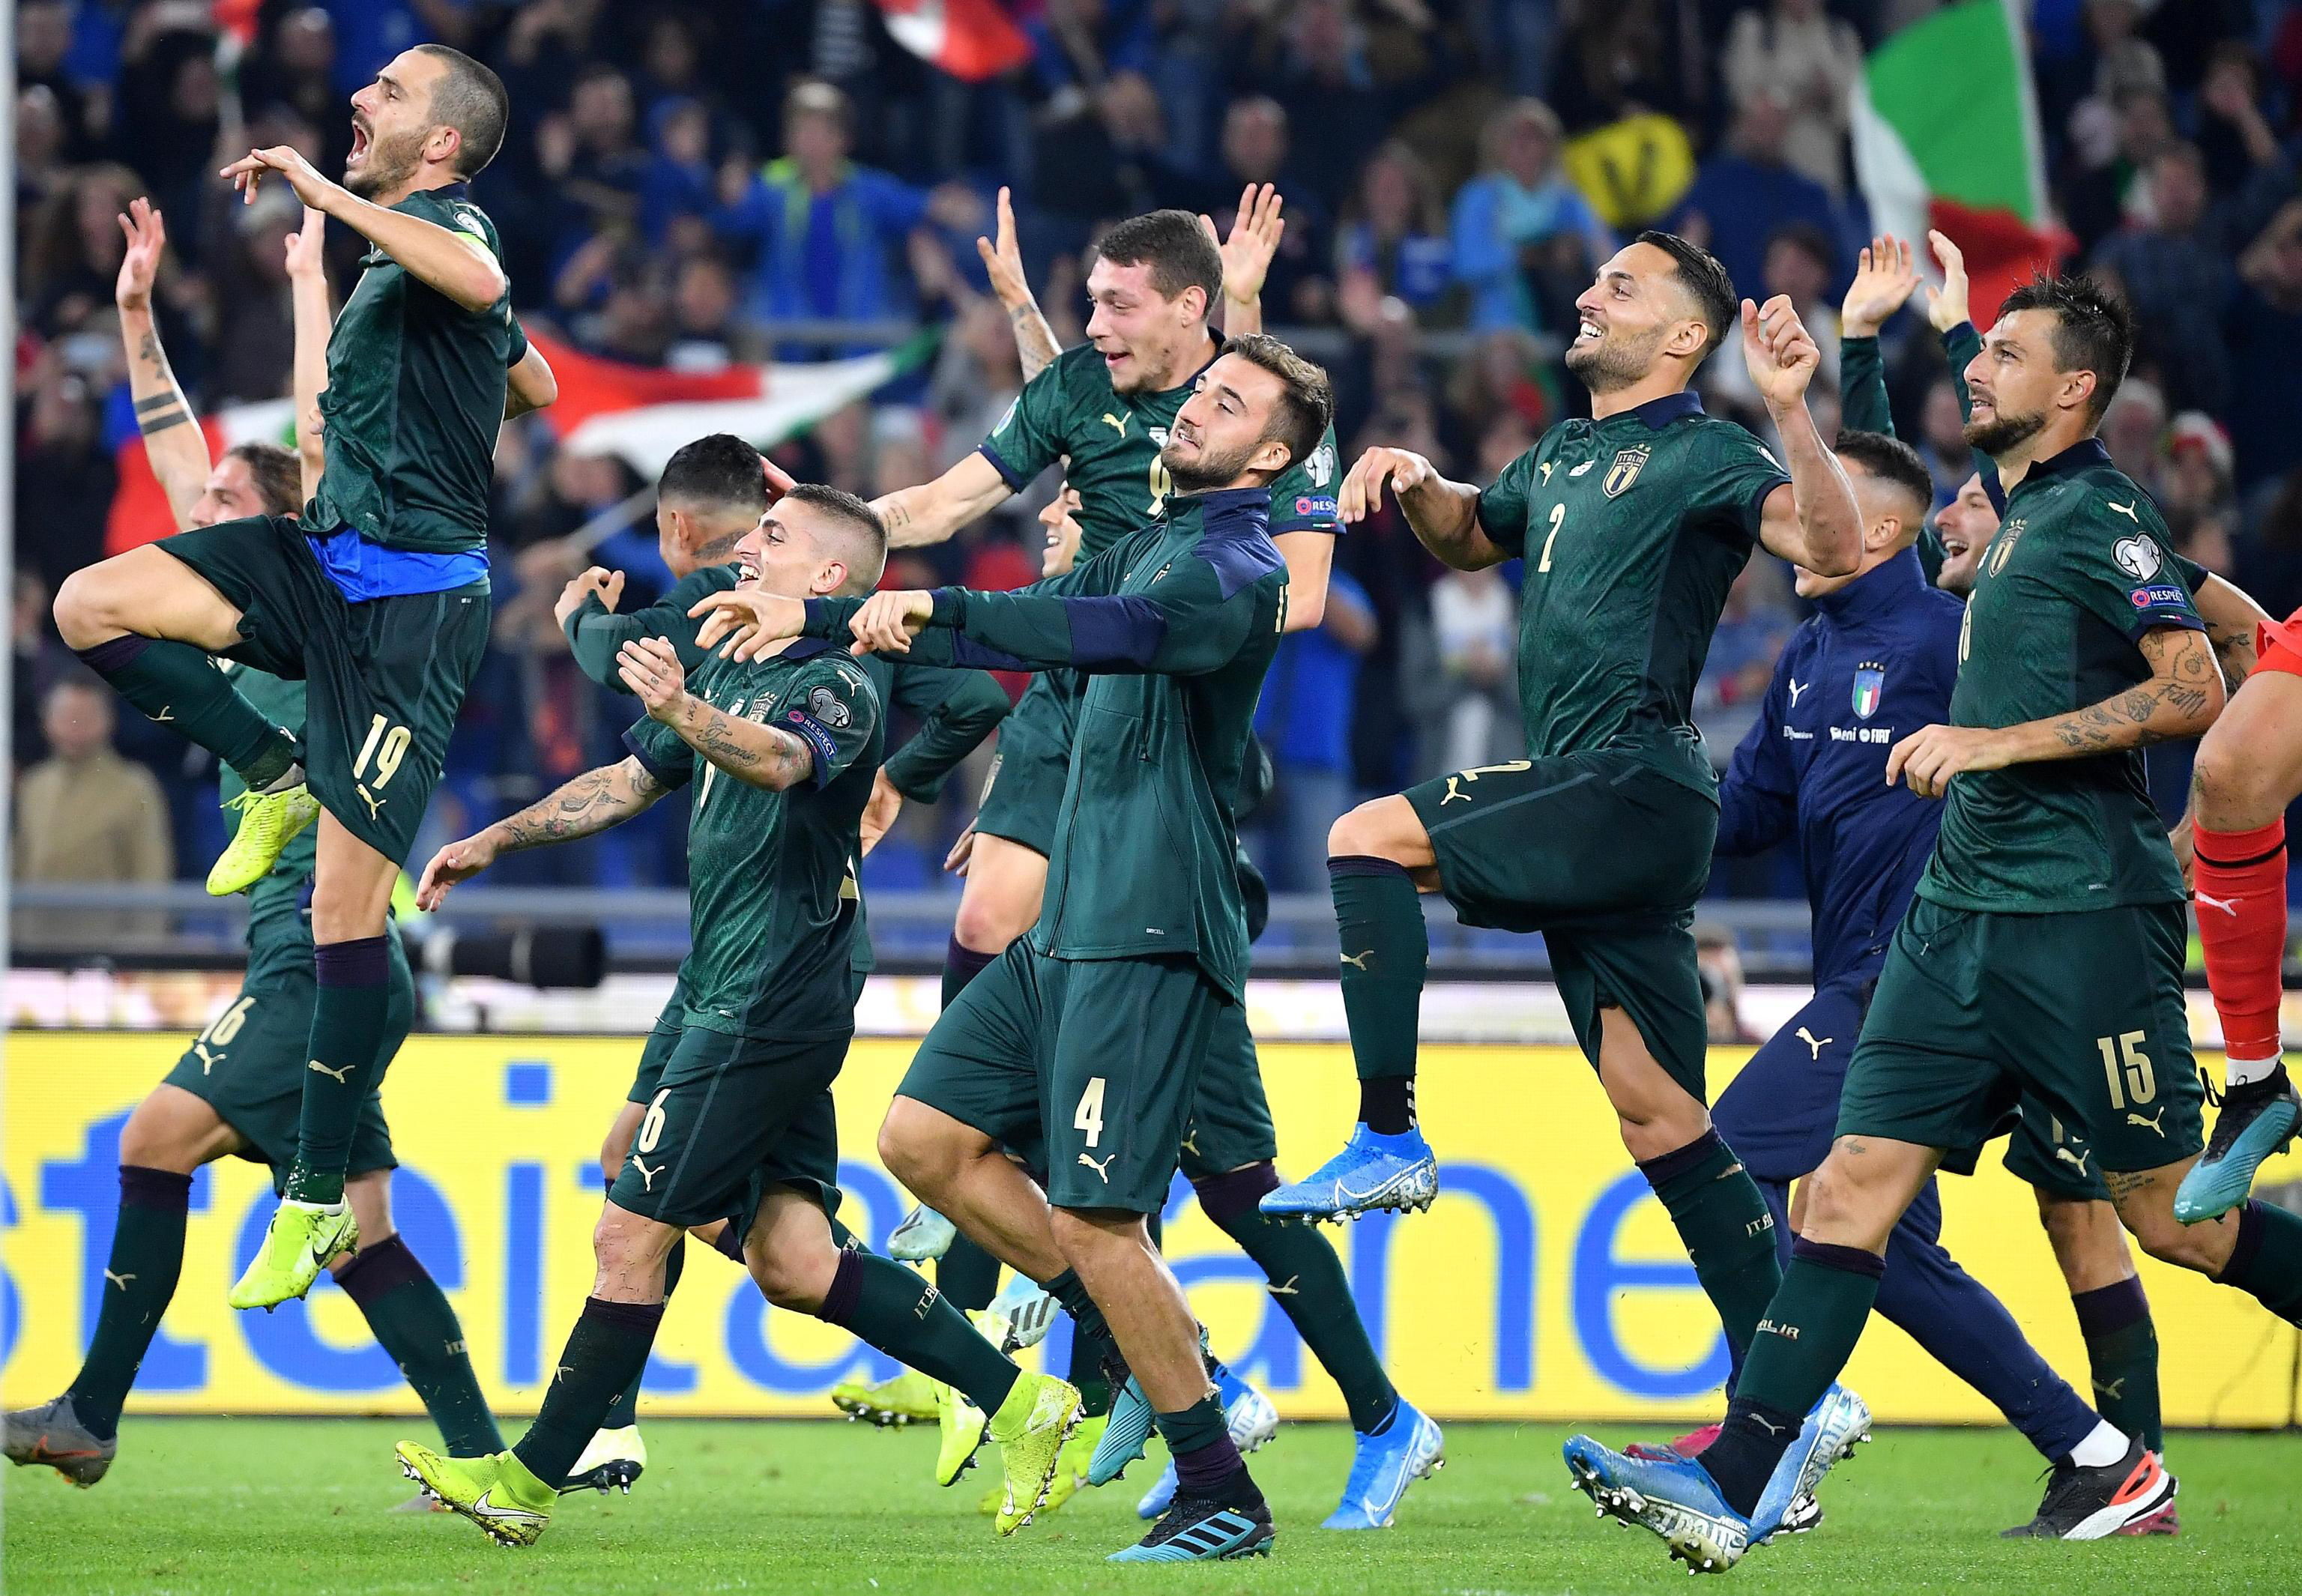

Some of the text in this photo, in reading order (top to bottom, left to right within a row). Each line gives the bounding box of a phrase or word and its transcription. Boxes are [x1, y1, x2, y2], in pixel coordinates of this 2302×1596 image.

[1619, 454, 1643, 464] ITALIA
[1538, 503, 1566, 573] 2
[2149, 589, 2185, 602] RESPECT
[353, 713, 411, 791] 19
[804, 719, 836, 757] RESPECT
[2097, 1029, 2157, 1110] 15
[638, 1087, 672, 1153] 6
[1073, 1076, 1106, 1148] 4
